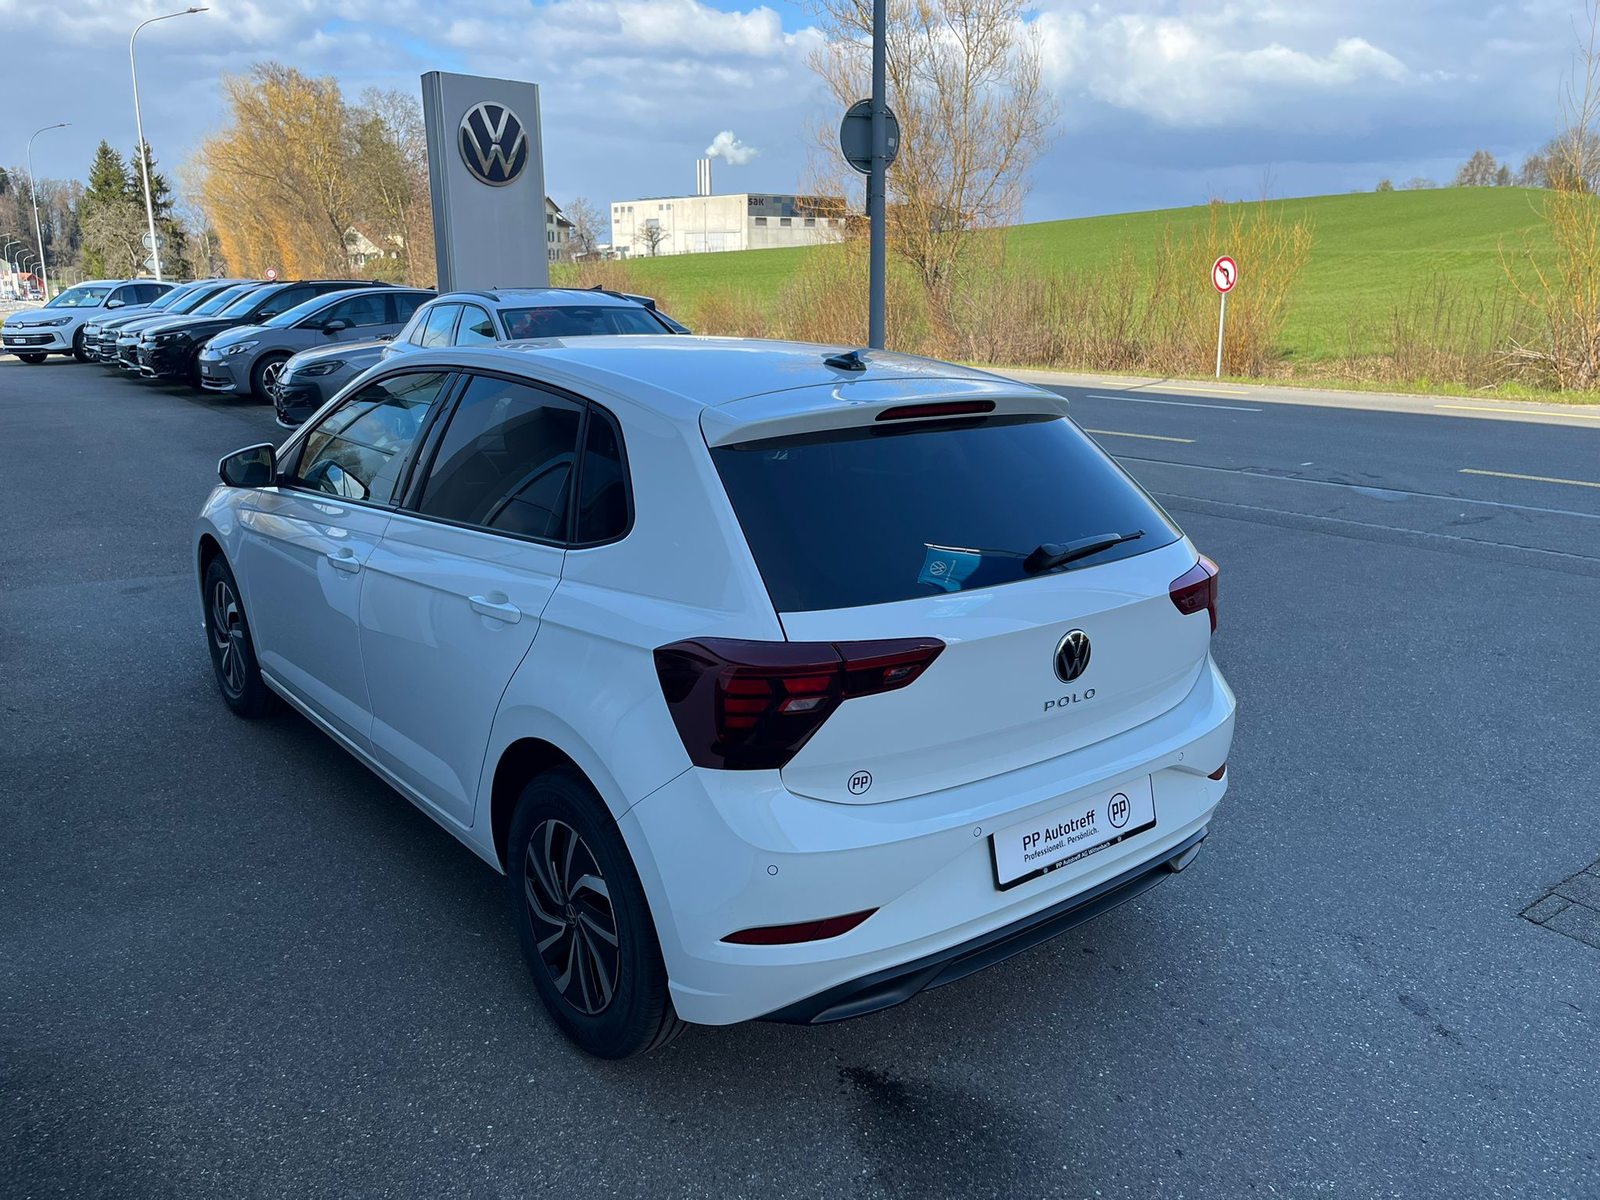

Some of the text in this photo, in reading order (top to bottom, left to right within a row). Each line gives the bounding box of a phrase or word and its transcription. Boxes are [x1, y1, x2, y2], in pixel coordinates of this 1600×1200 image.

[1043, 688, 1096, 712] POLO
[852, 775, 869, 790] PP
[1112, 799, 1127, 821] PP
[1022, 809, 1096, 851] PP Autotreff
[1024, 827, 1100, 862] Professionell. Persönlich.
